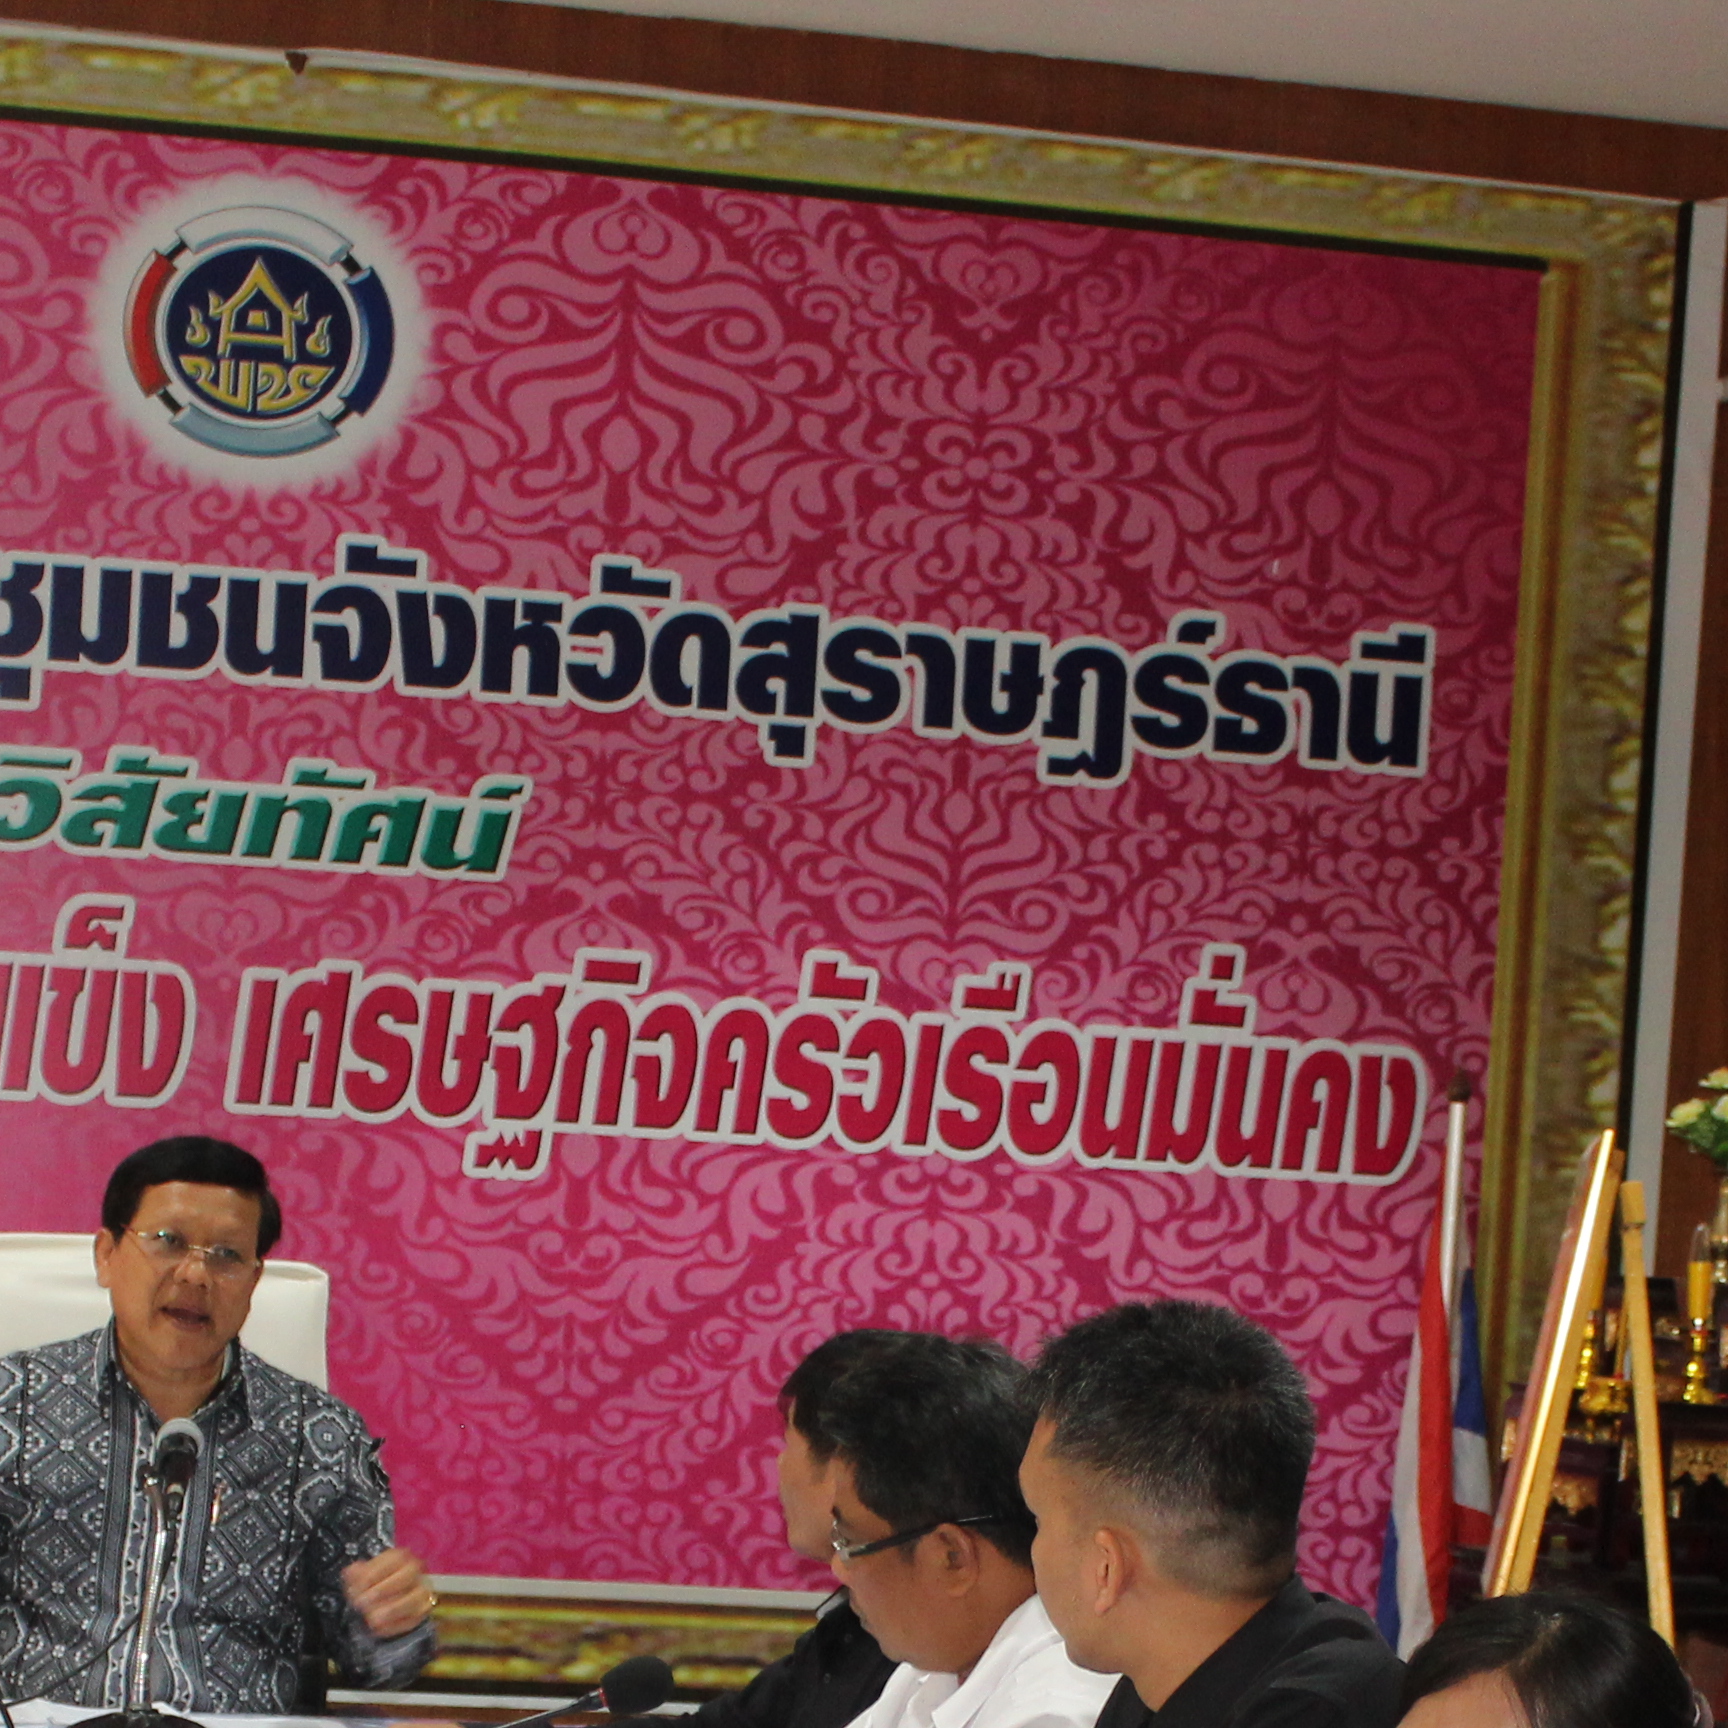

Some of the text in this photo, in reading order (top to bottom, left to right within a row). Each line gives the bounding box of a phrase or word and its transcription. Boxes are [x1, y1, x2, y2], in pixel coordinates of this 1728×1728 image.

[230, 950, 1424, 1178] เศรษฐกิจครัวเรือนมั่นคง
